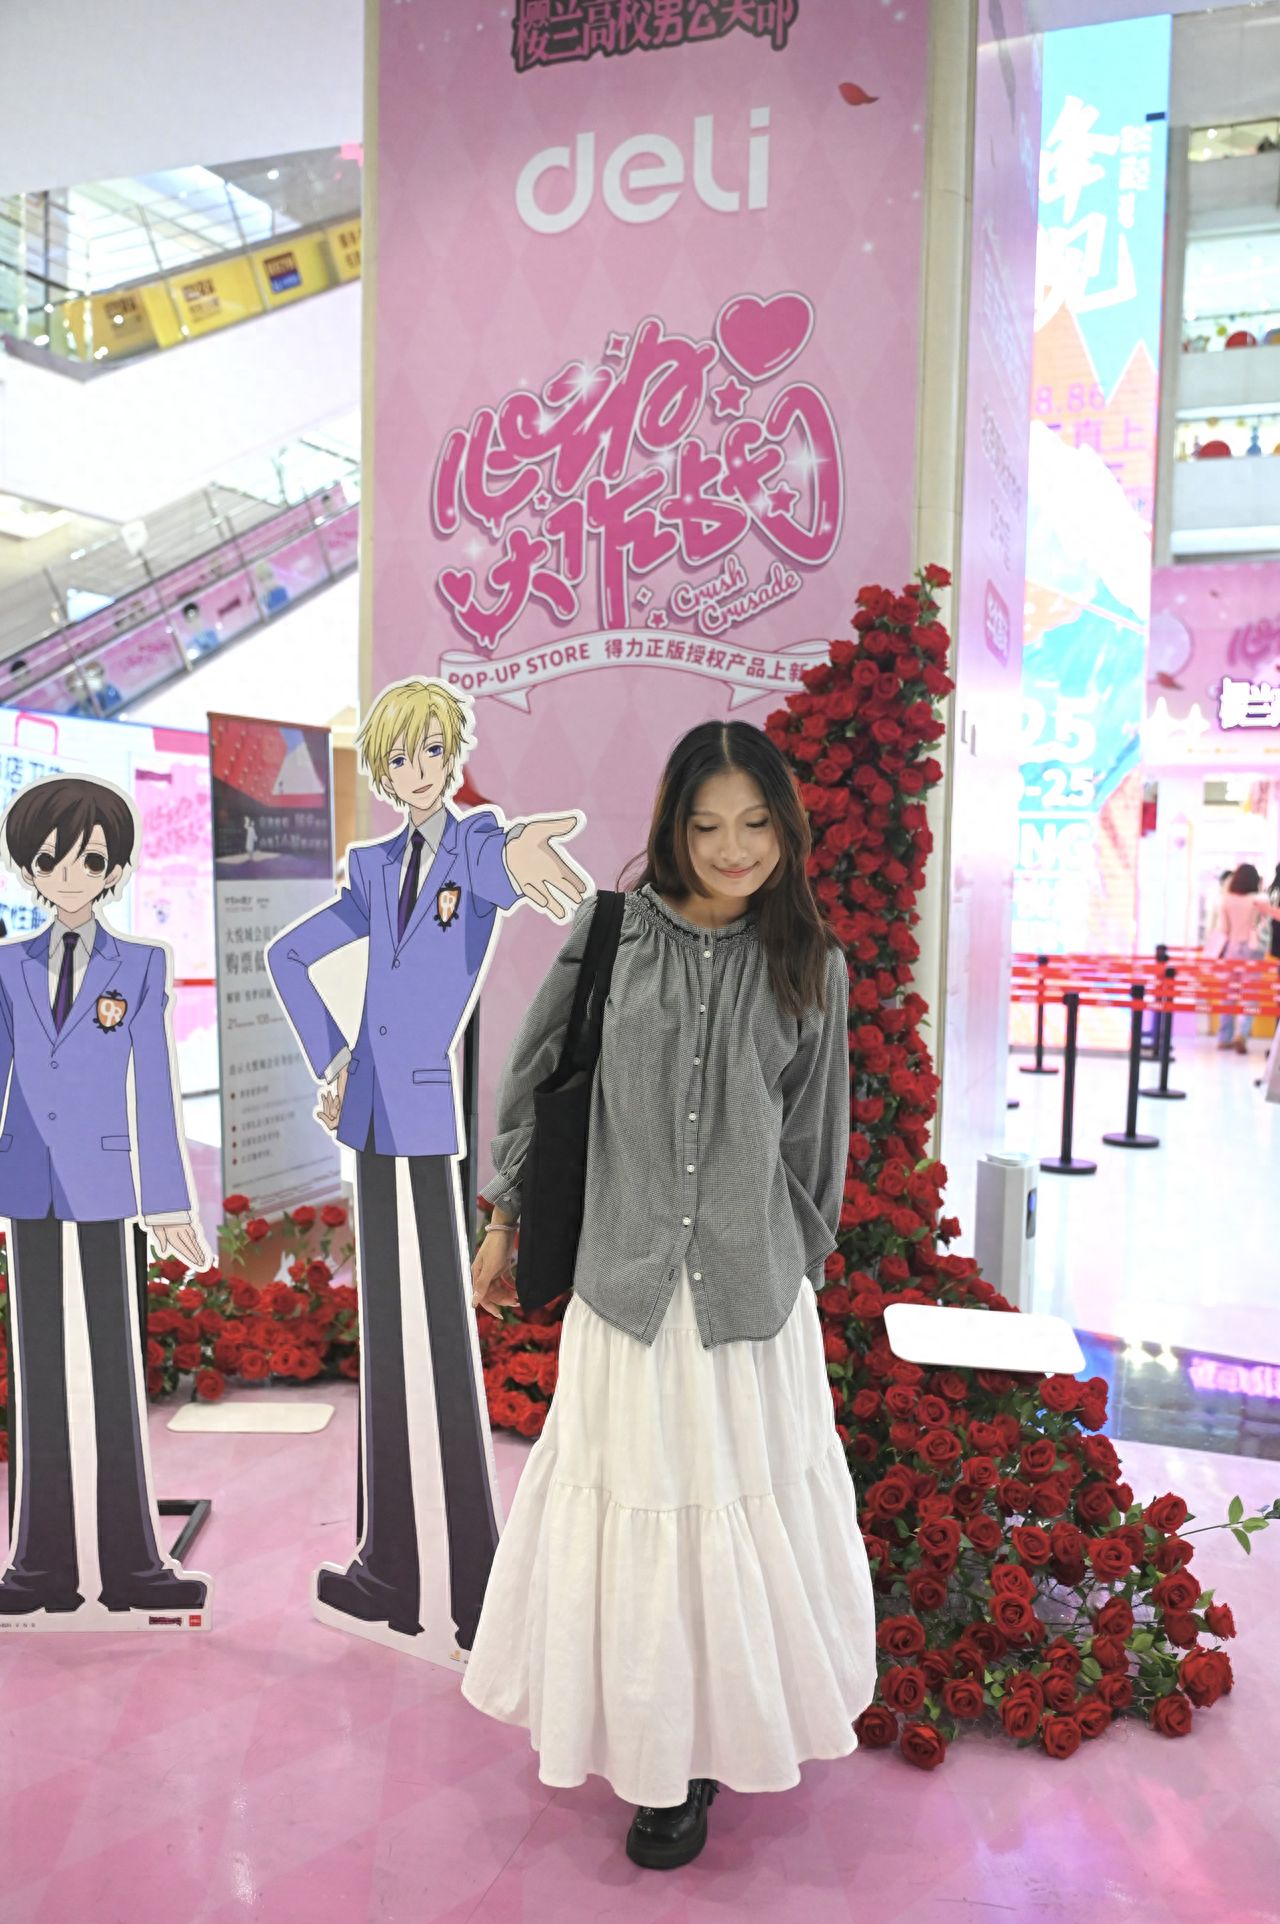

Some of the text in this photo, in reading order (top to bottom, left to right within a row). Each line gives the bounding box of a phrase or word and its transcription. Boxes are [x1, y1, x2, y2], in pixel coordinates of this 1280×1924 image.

[514, 105, 771, 235] deli
[672, 554, 747, 617] Crush
[699, 562, 802, 635] Crusade
[448, 643, 590, 690] POP-UP STORE
